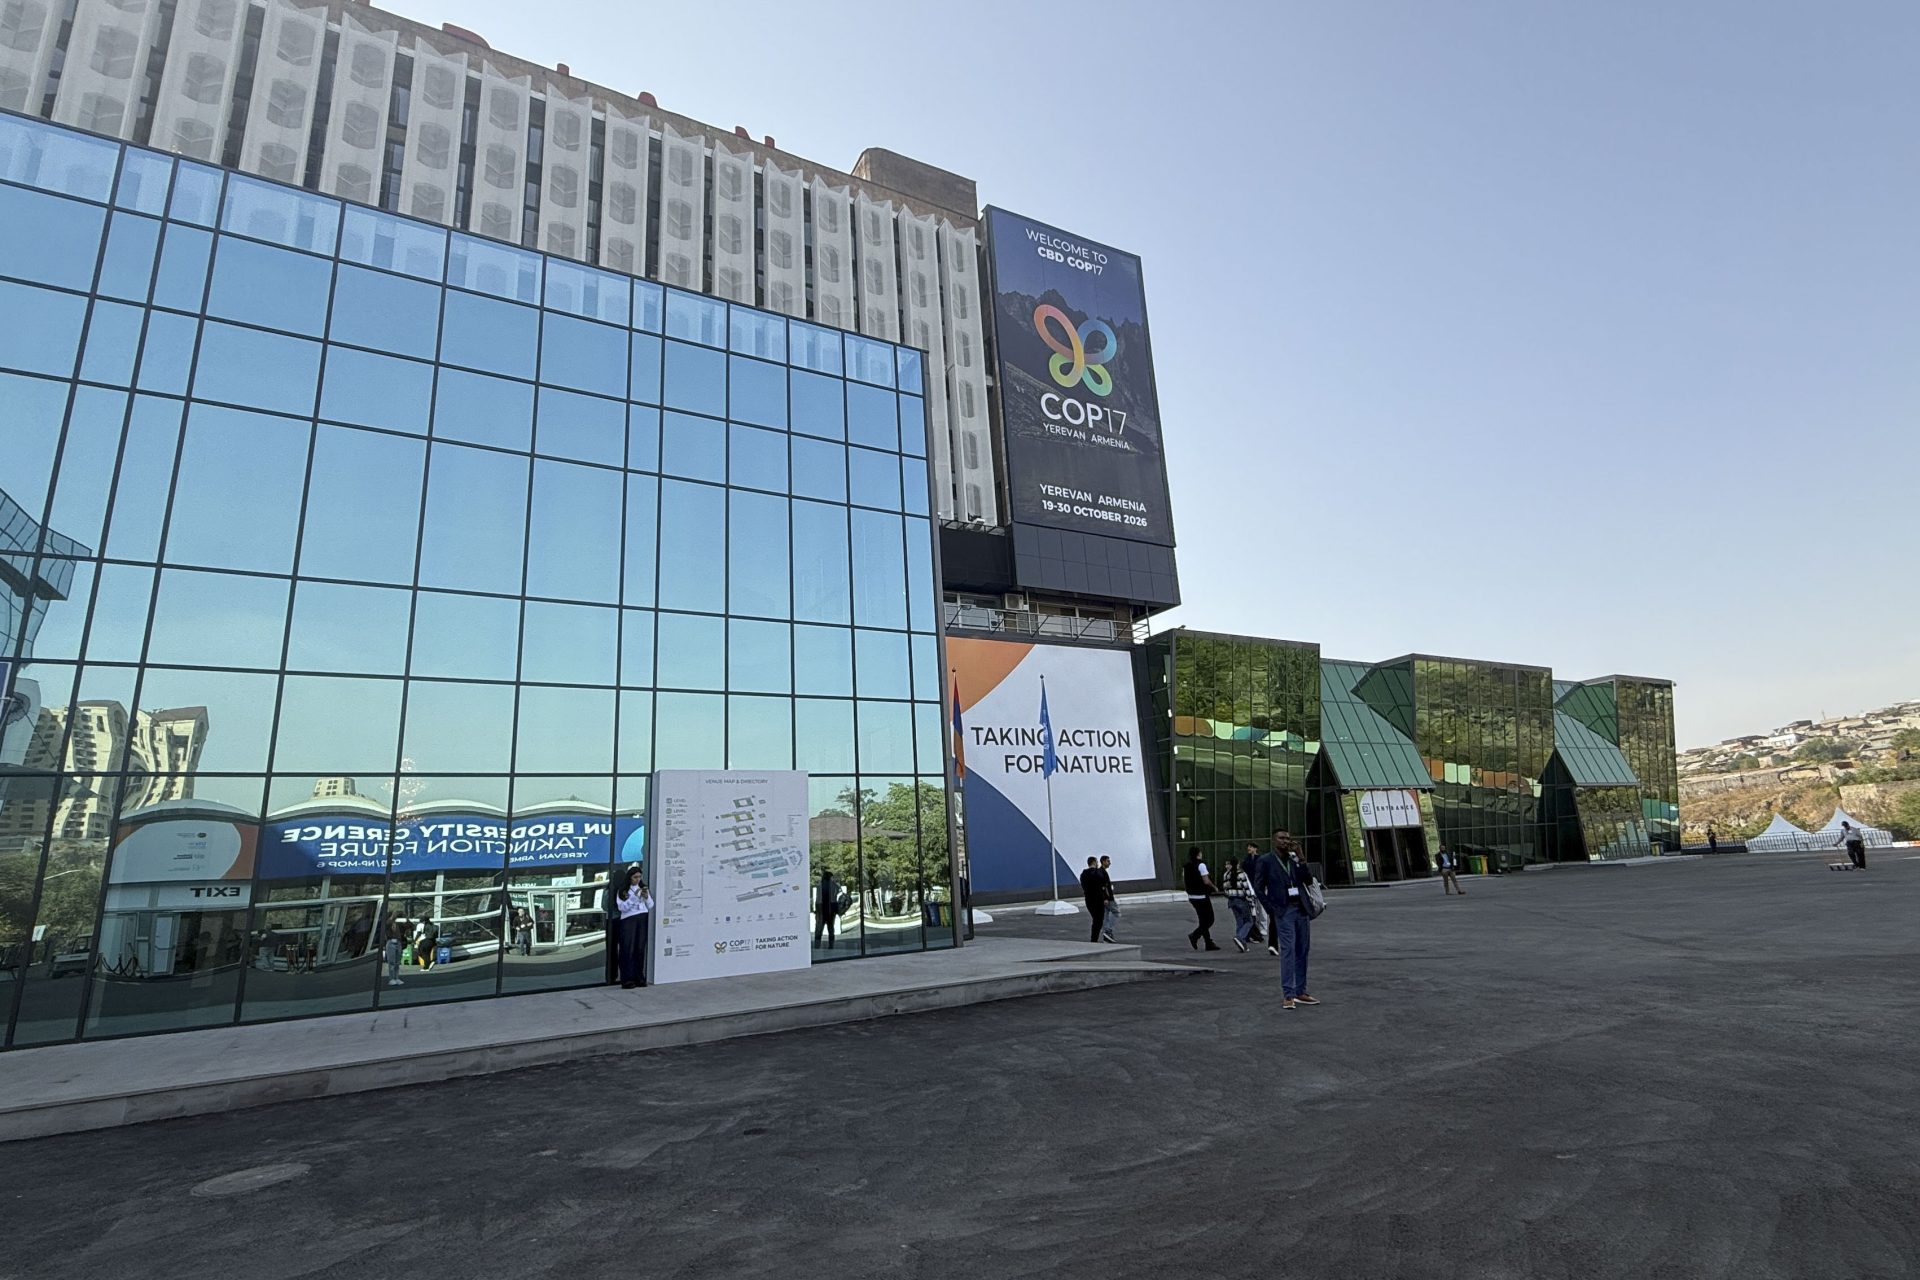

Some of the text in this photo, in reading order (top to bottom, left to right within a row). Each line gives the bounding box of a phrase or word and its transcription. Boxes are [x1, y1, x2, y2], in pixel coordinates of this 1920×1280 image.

[1026, 228, 1107, 264] WELCOME TO
[1038, 246, 1102, 275] CBD COP17
[1040, 392, 1126, 435] COP17
[1043, 422, 1130, 450] YEREVAN ARMENIA
[1040, 484, 1146, 512] YEREVAN ARMENIA
[1042, 500, 1147, 527] 19-30 OCTOBER 2026
[1058, 729, 1130, 747] ACTION
[1005, 755, 1134, 773] FOR NATURE
[729, 939, 750, 947] COP17
